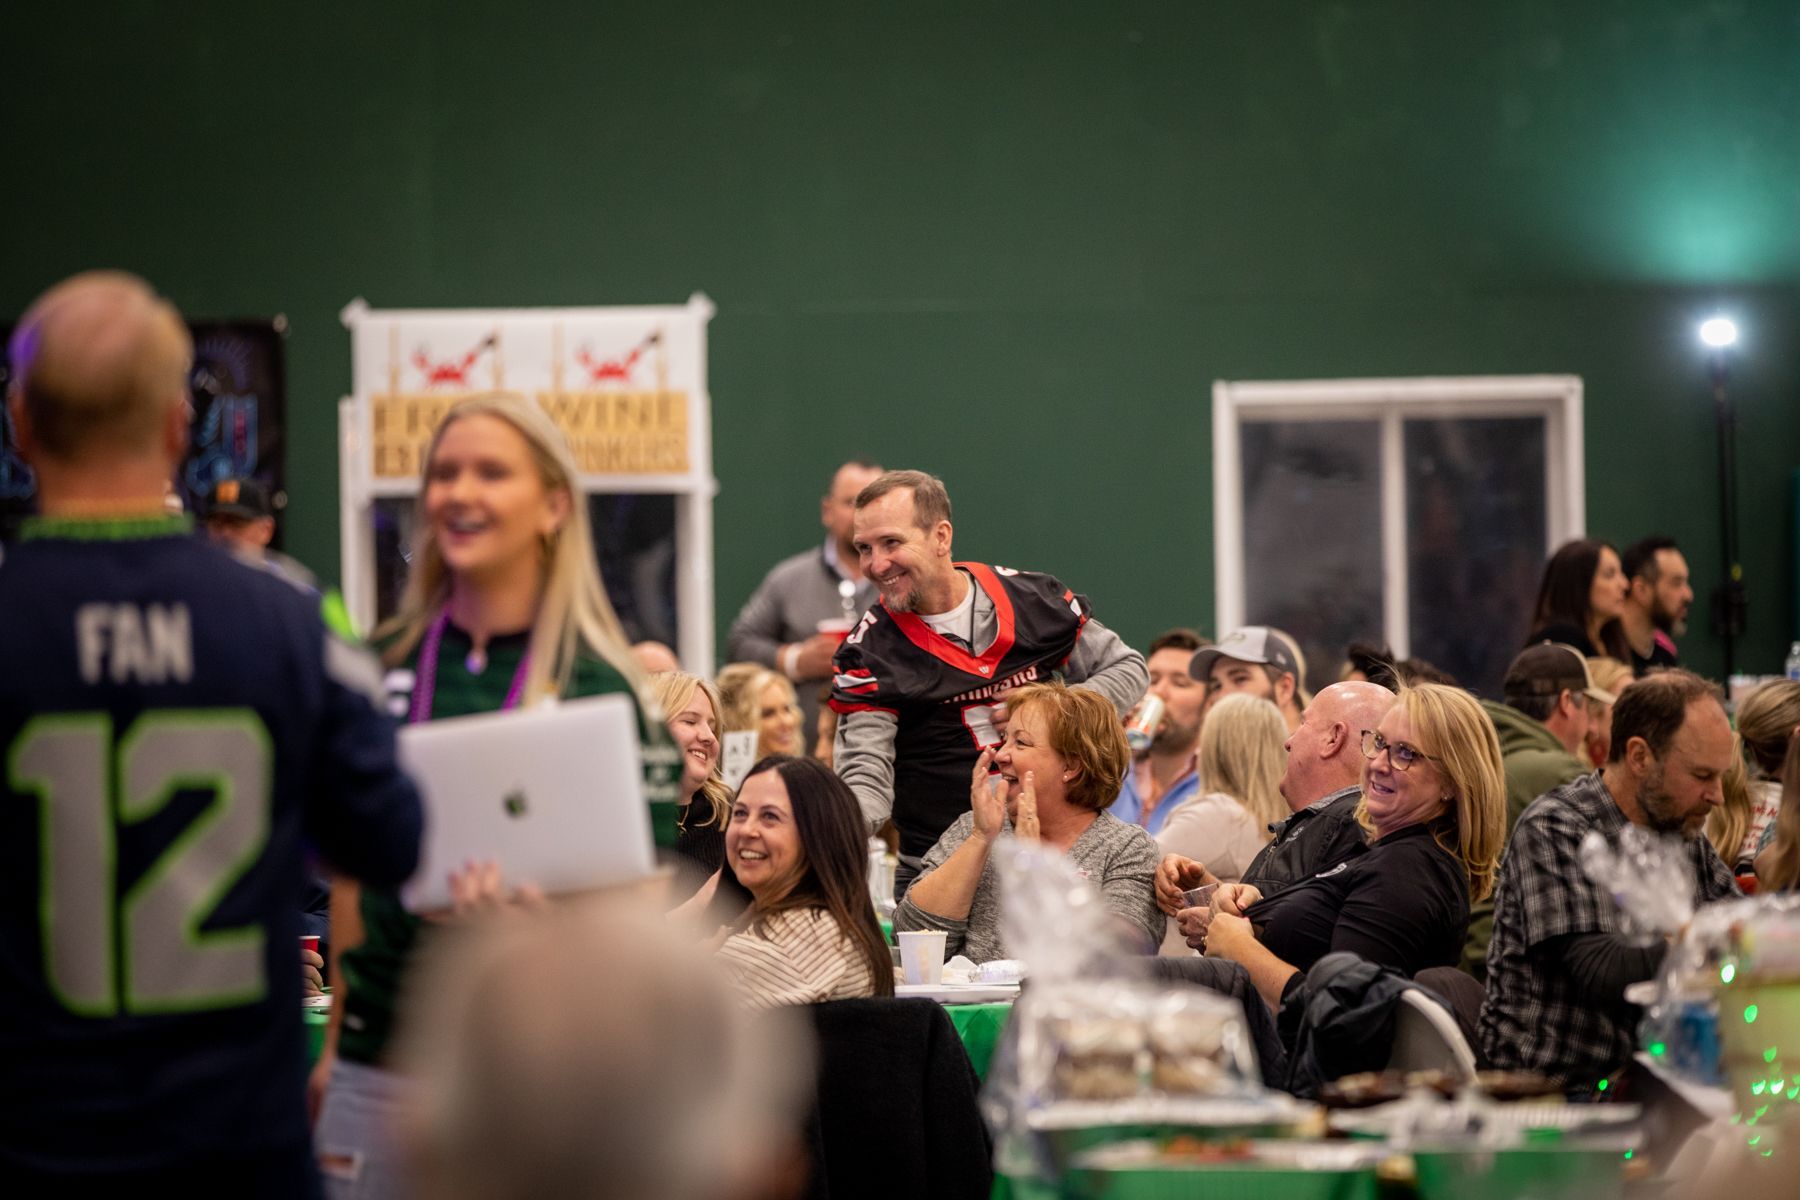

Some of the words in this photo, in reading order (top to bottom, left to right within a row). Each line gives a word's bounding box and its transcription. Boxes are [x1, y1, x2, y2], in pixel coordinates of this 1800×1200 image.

[536, 393, 681, 430] WINE
[76, 602, 193, 685] FAN
[8, 707, 274, 1017] 12
